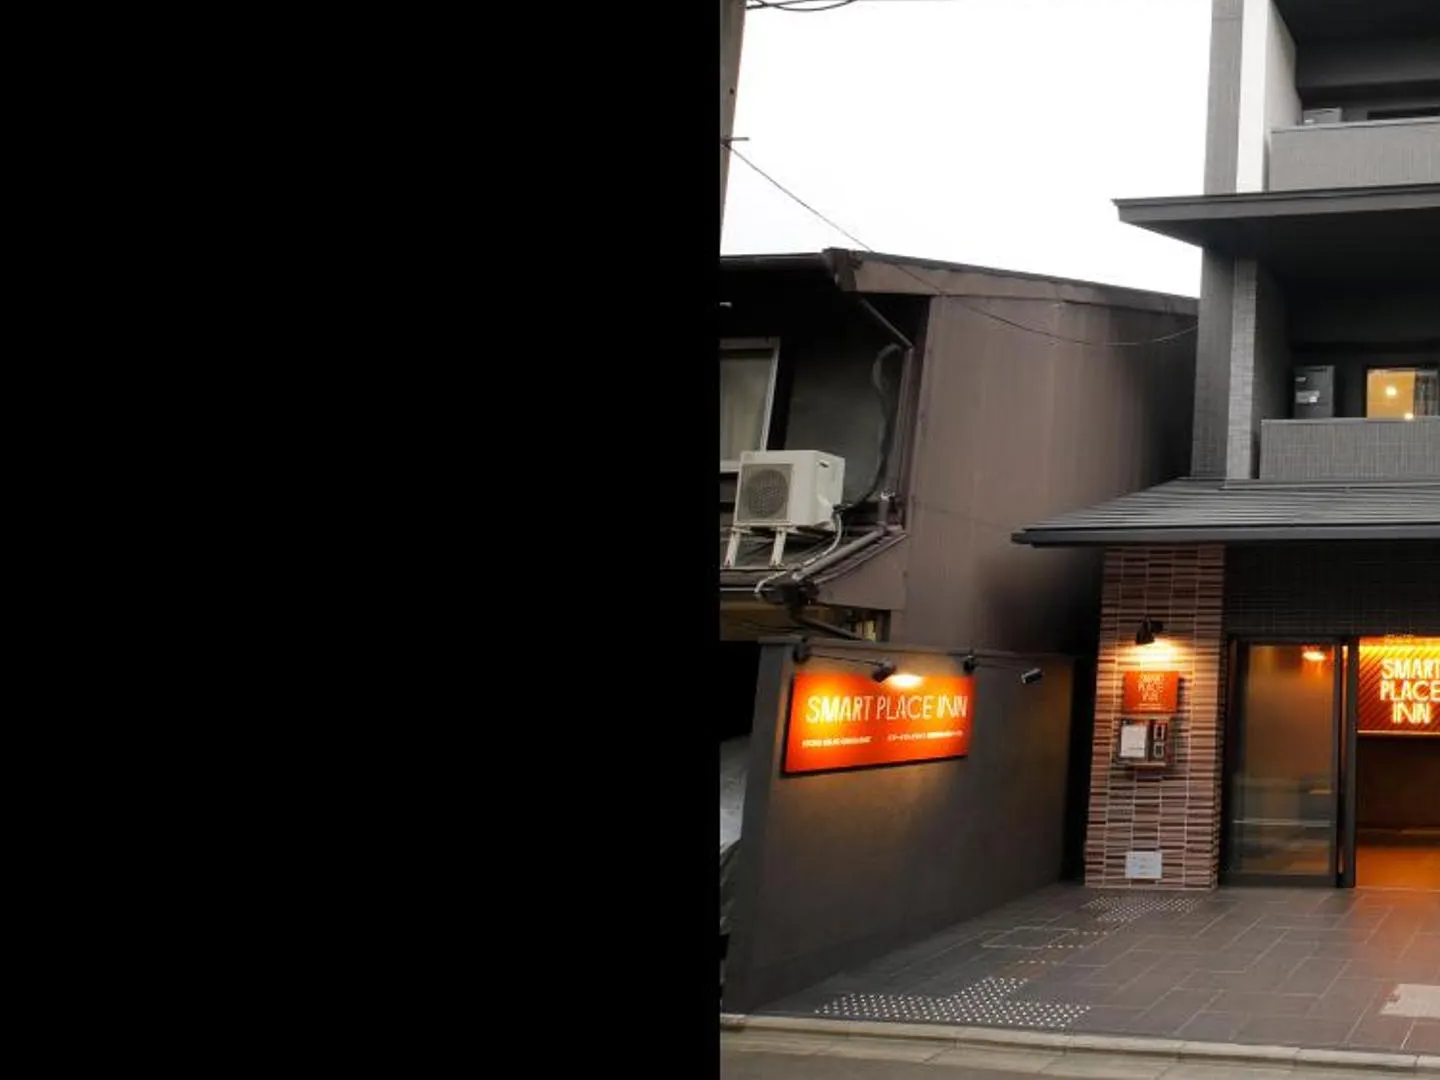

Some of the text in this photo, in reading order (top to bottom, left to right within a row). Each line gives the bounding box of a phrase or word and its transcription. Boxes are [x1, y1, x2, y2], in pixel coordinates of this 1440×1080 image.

[806, 694, 968, 724] SMART PLACE INN
[1392, 701, 1431, 724] INN
